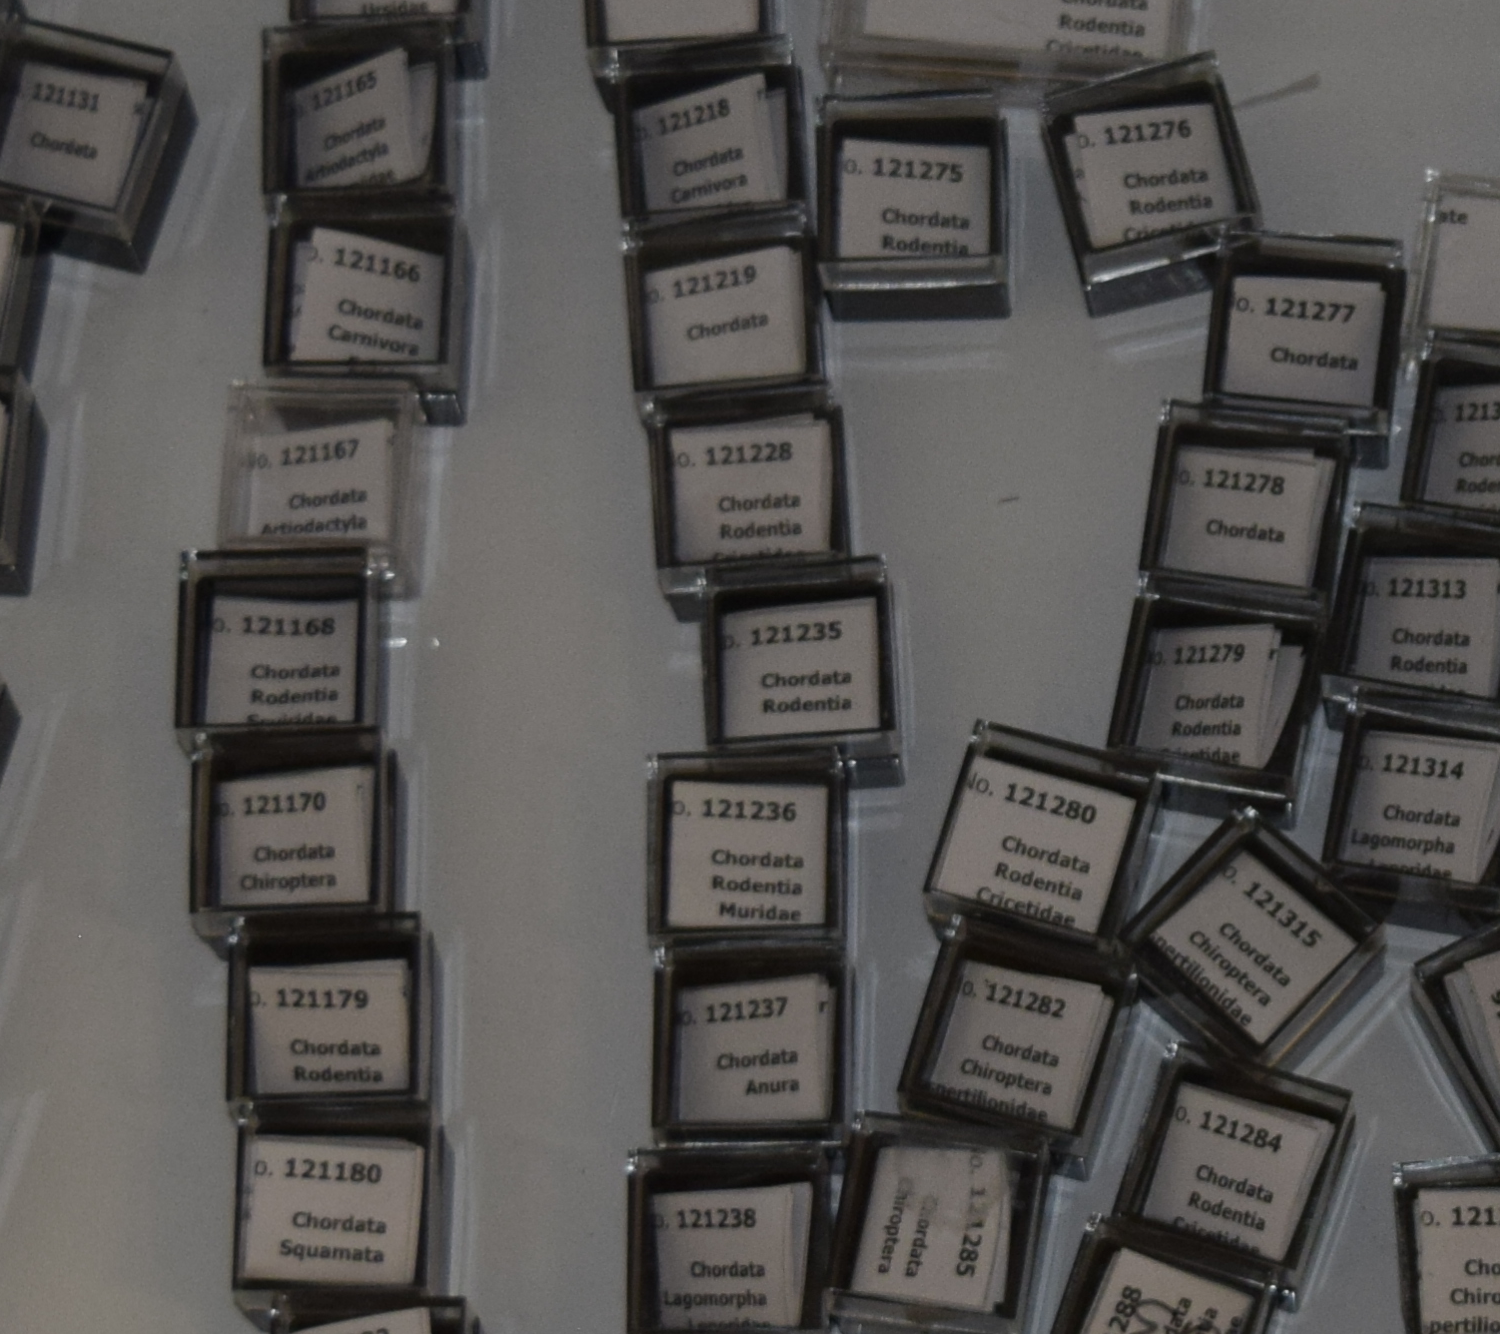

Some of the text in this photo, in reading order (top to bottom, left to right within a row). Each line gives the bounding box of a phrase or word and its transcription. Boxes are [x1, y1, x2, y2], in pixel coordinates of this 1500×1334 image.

[1104, 119, 1191, 145] 121276
[873, 157, 963, 183] 121275
[334, 248, 420, 283] 121166
[673, 265, 756, 298] 121219
[1265, 297, 1356, 323] 121277
[706, 442, 792, 466] 121228
[1203, 469, 1285, 496] 121278
[1388, 578, 1466, 600] 121313
[243, 616, 335, 636] 121168
[751, 621, 841, 646] 121235
[1174, 643, 1245, 665] 121279
[1382, 754, 1464, 780] 121314
[702, 799, 796, 822] 121236
[1004, 783, 1096, 824] 121280
[1001, 836, 1090, 874] Chordata
[1243, 882, 1322, 948] 121315
[277, 988, 368, 1009] 121179
[706, 996, 788, 1023] 121237
[985, 979, 1066, 1019] 121282
[1199, 1111, 1282, 1154] 121284
[284, 1158, 381, 1183] 121180
[291, 1212, 386, 1235] Chordata
[280, 1240, 384, 1264] Squamata
